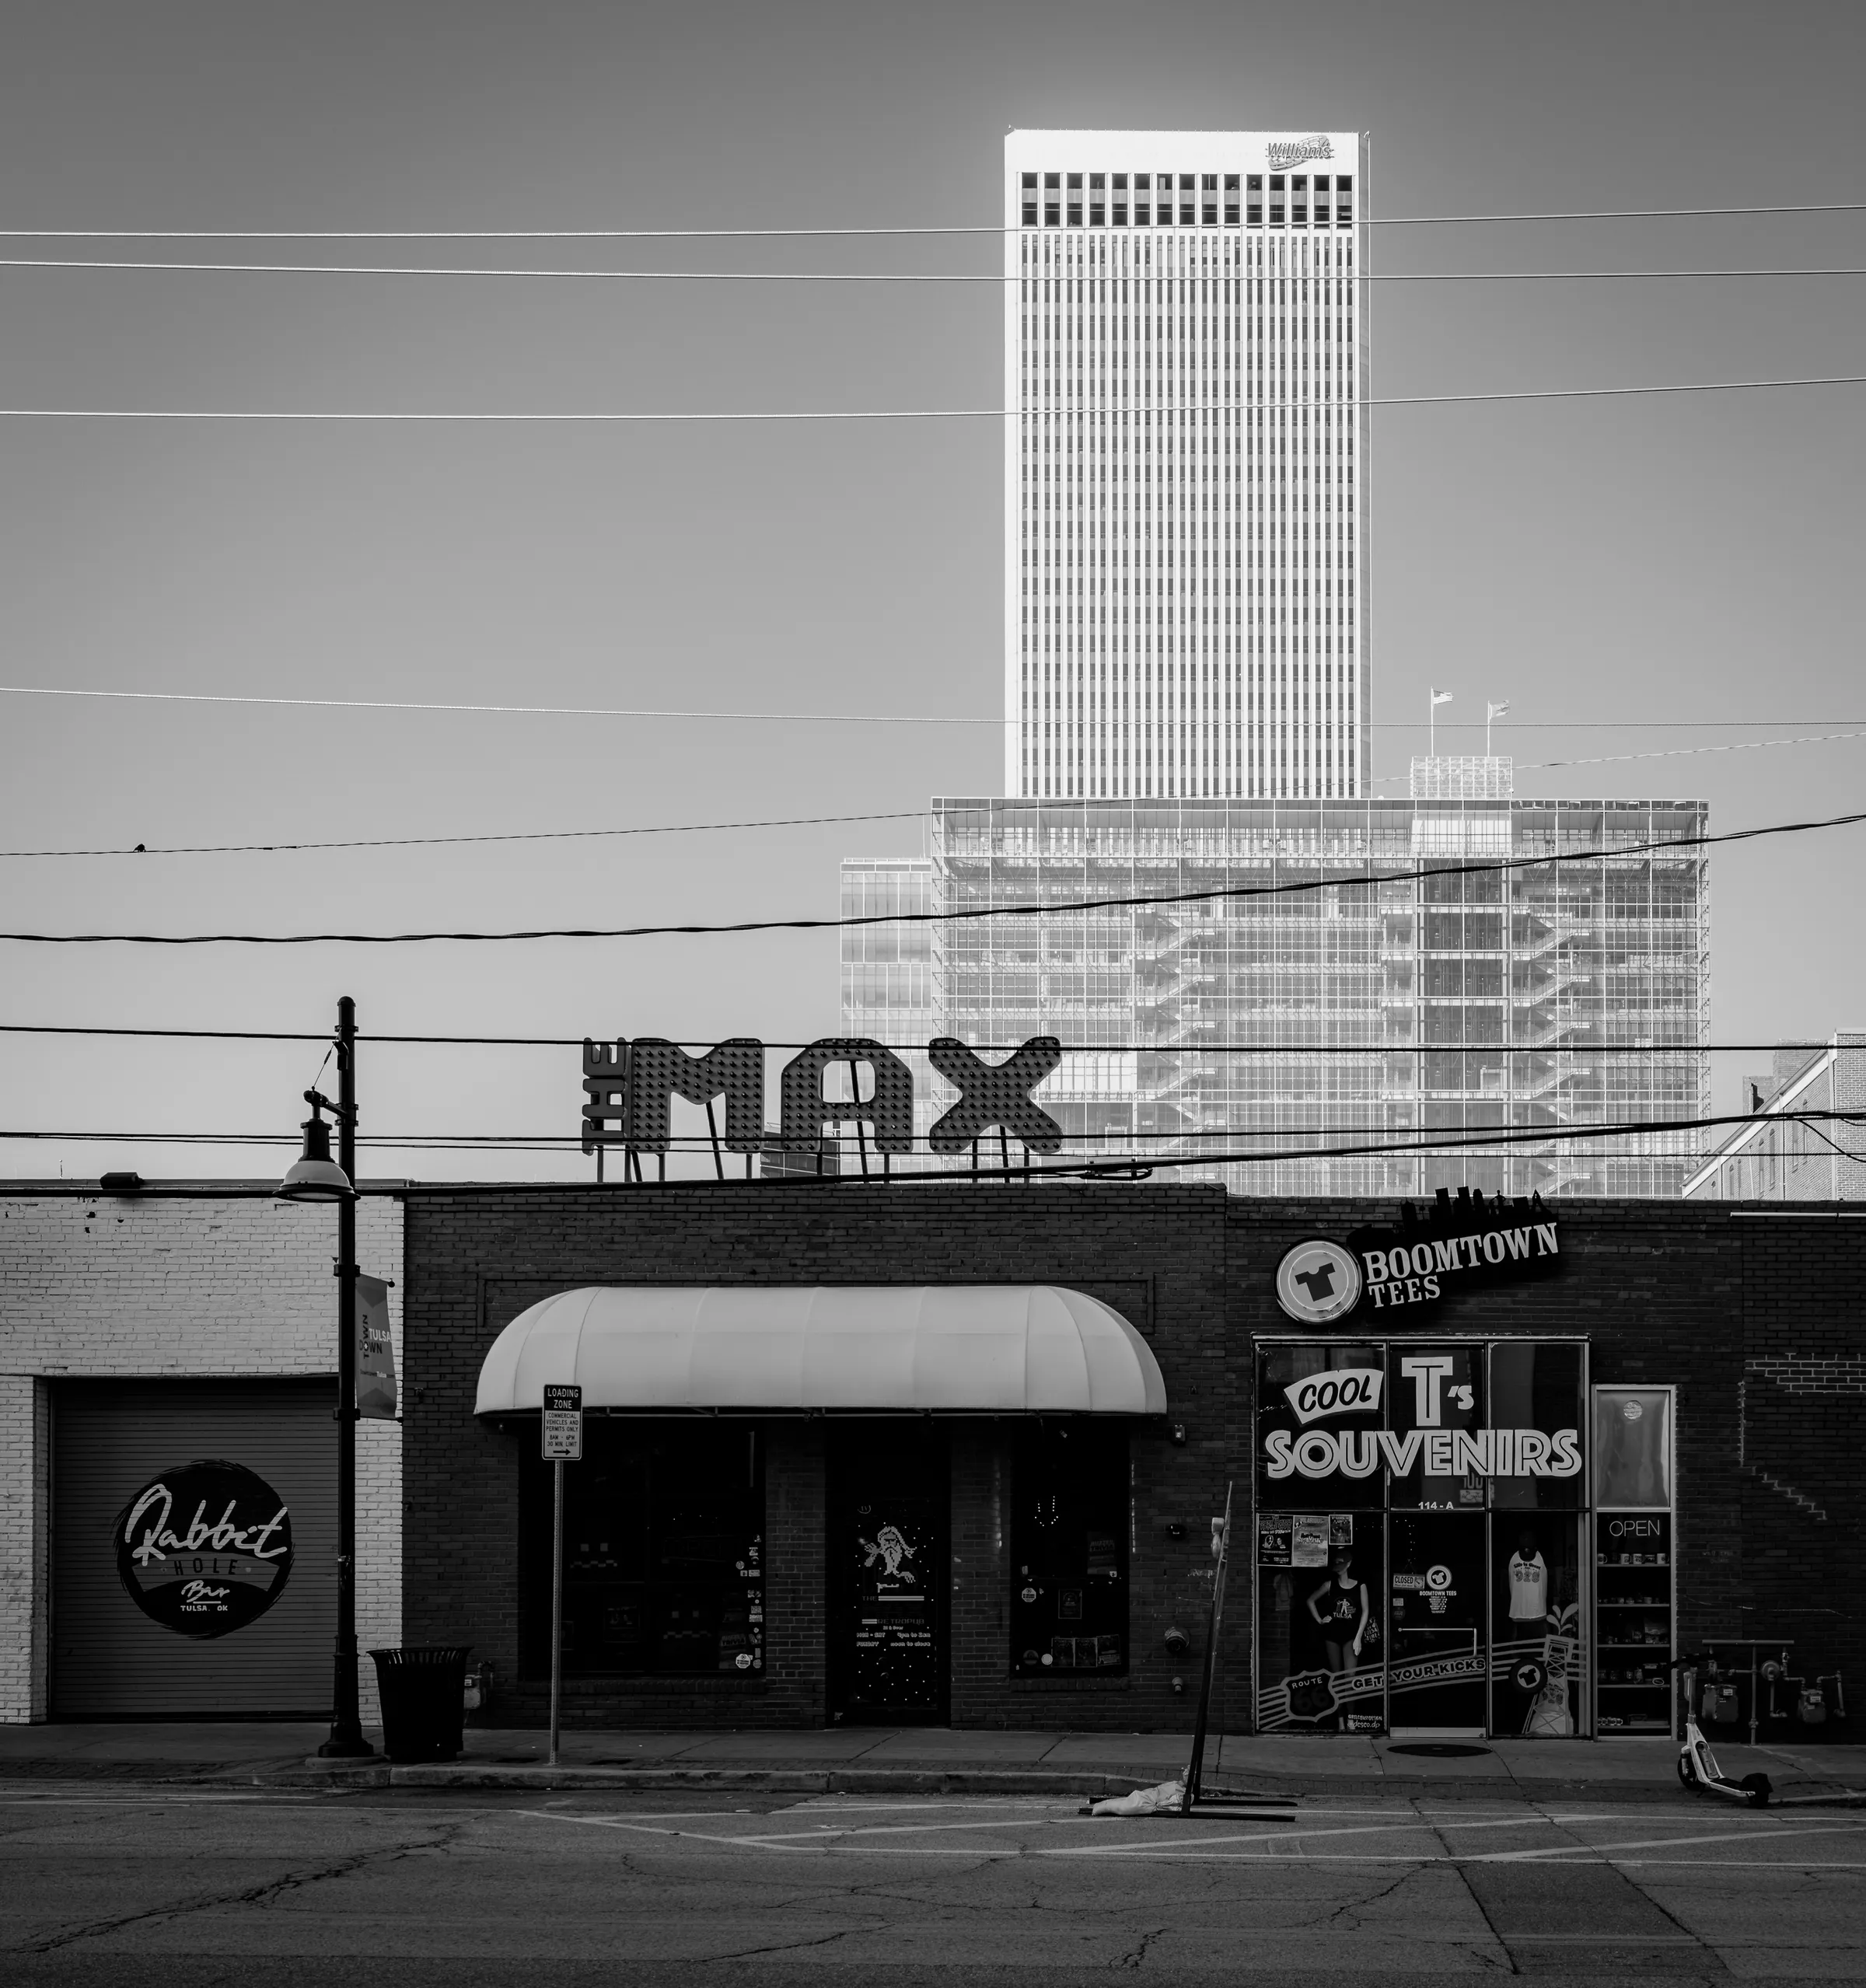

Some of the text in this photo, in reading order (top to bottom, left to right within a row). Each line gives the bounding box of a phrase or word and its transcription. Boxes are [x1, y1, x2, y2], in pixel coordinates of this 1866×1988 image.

[1267, 142, 1331, 158] Williams
[582, 1036, 1062, 1155] THE MAX
[1362, 1222, 1559, 1284] BOOMTOWN
[1368, 1275, 1441, 1308] TEES
[369, 1328, 392, 1343] TULSA
[359, 1340, 383, 1354] DOWN
[547, 1388, 579, 1398] LOADING
[1298, 1374, 1372, 1413] COOL
[554, 1399, 573, 1410] ZONE
[1265, 1429, 1582, 1478] SOUVENIRS
[1417, 1501, 1437, 1510] 114
[1445, 1501, 1454, 1510] A
[124, 1483, 288, 1567] Rabbit
[1609, 1520, 1660, 1536] OPEN
[174, 1557, 238, 1576] HOLE
[1394, 1576, 1413, 1584] CLOSED
[1333, 1611, 1353, 1619] TULSA
[1291, 1676, 1323, 1689] ROUTE
[1351, 1658, 1486, 1691] GET YOUR KICKS
[1293, 1684, 1330, 1712] 66
